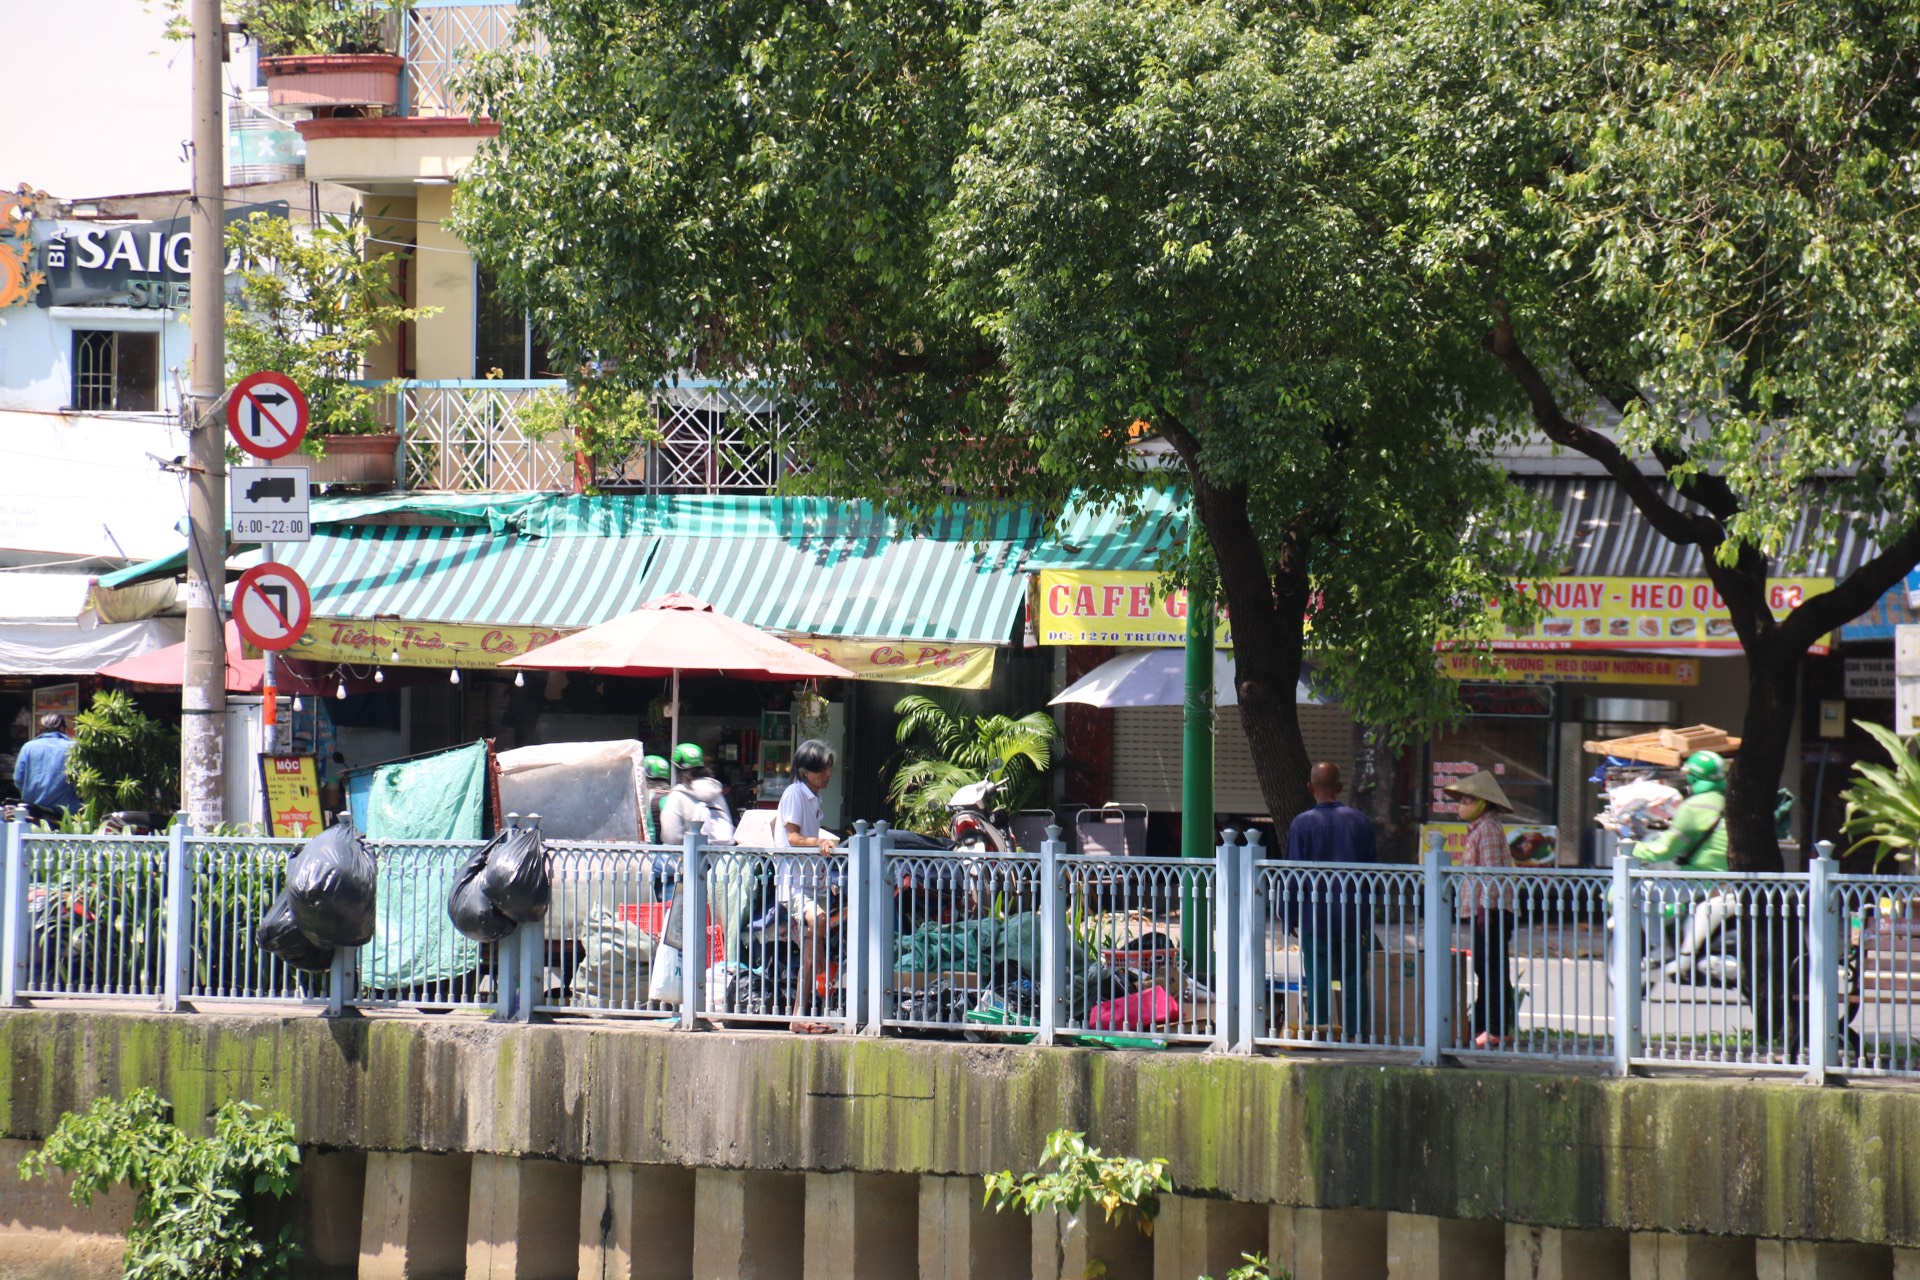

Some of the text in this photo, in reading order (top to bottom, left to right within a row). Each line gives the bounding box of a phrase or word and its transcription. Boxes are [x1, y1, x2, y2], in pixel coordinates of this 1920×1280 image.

[48, 228, 68, 267] BIA
[1048, 584, 1151, 618] CAFE
[1630, 583, 1684, 609] HEO
[1080, 631, 1120, 642] 1270
[276, 759, 300, 773] MỘC
